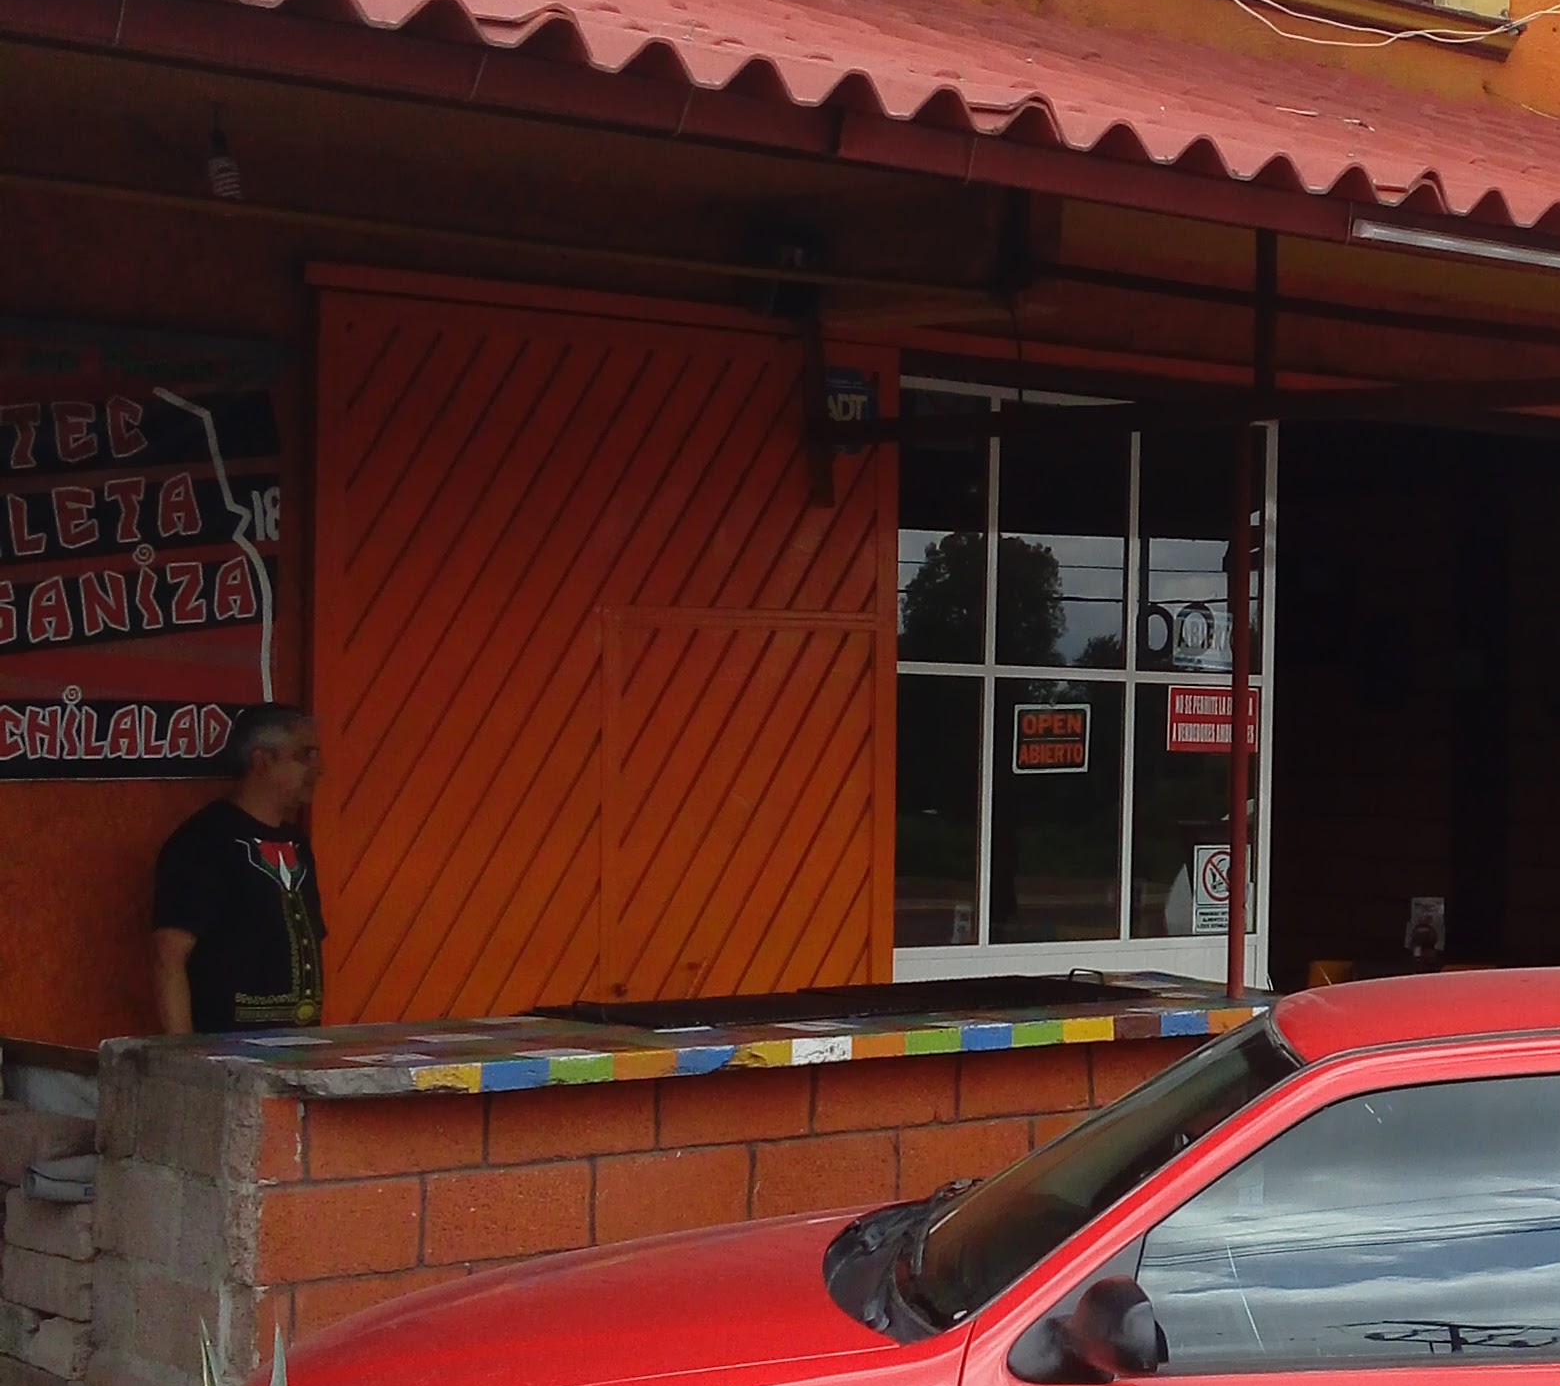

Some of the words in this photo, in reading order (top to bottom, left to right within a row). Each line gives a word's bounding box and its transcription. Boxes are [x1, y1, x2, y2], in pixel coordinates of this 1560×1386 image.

[0, 395, 148, 469] TEC
[0, 685, 245, 760] CHILALAD
[1022, 713, 1083, 735] OPEN
[1018, 743, 1084, 766] ABIERTO
